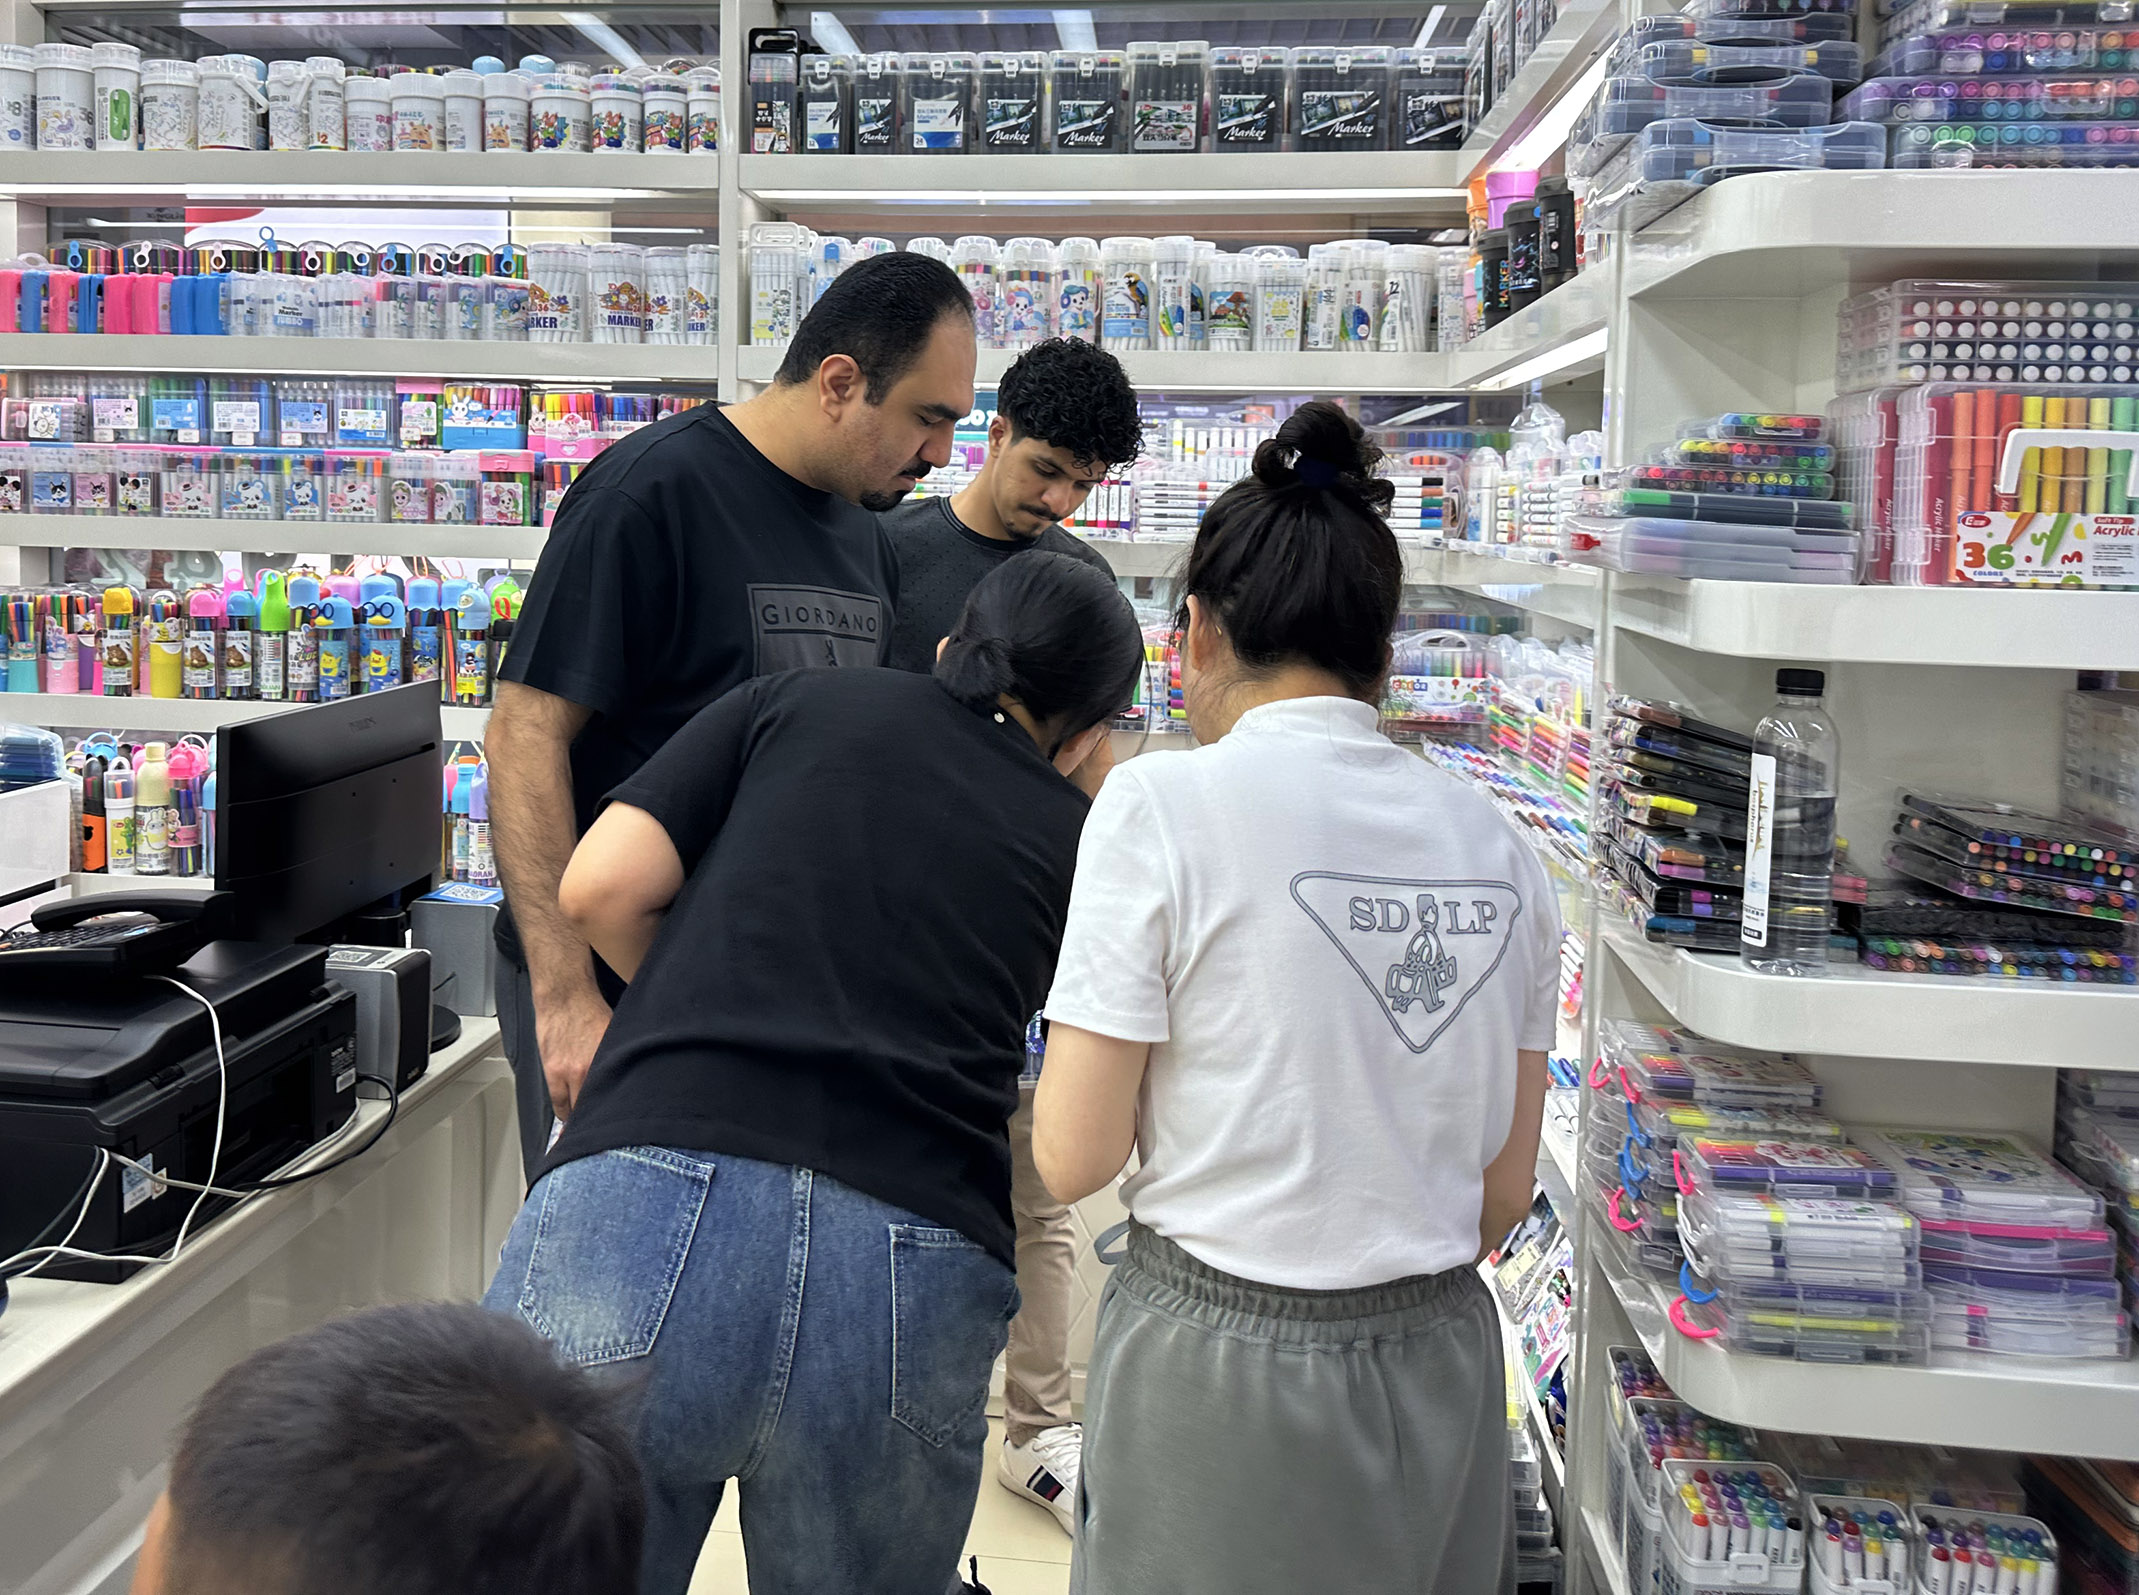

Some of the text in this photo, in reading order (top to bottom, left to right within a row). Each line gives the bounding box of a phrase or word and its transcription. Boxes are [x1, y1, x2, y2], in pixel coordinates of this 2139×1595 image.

[1224, 126, 1266, 139] Marker
[1327, 121, 1374, 136] Marker
[860, 133, 890, 142] Marker
[988, 130, 1030, 143] Marker
[1064, 131, 1105, 144] Marker
[279, 308, 303, 316] Marker
[537, 303, 550, 312] 36
[1934, 497, 1944, 525] Acrylic
[2093, 525, 2135, 537] Acrylic
[1963, 542, 2016, 570] 36
[762, 604, 877, 633] GIORDANO
[1349, 896, 1497, 935] SD LP
